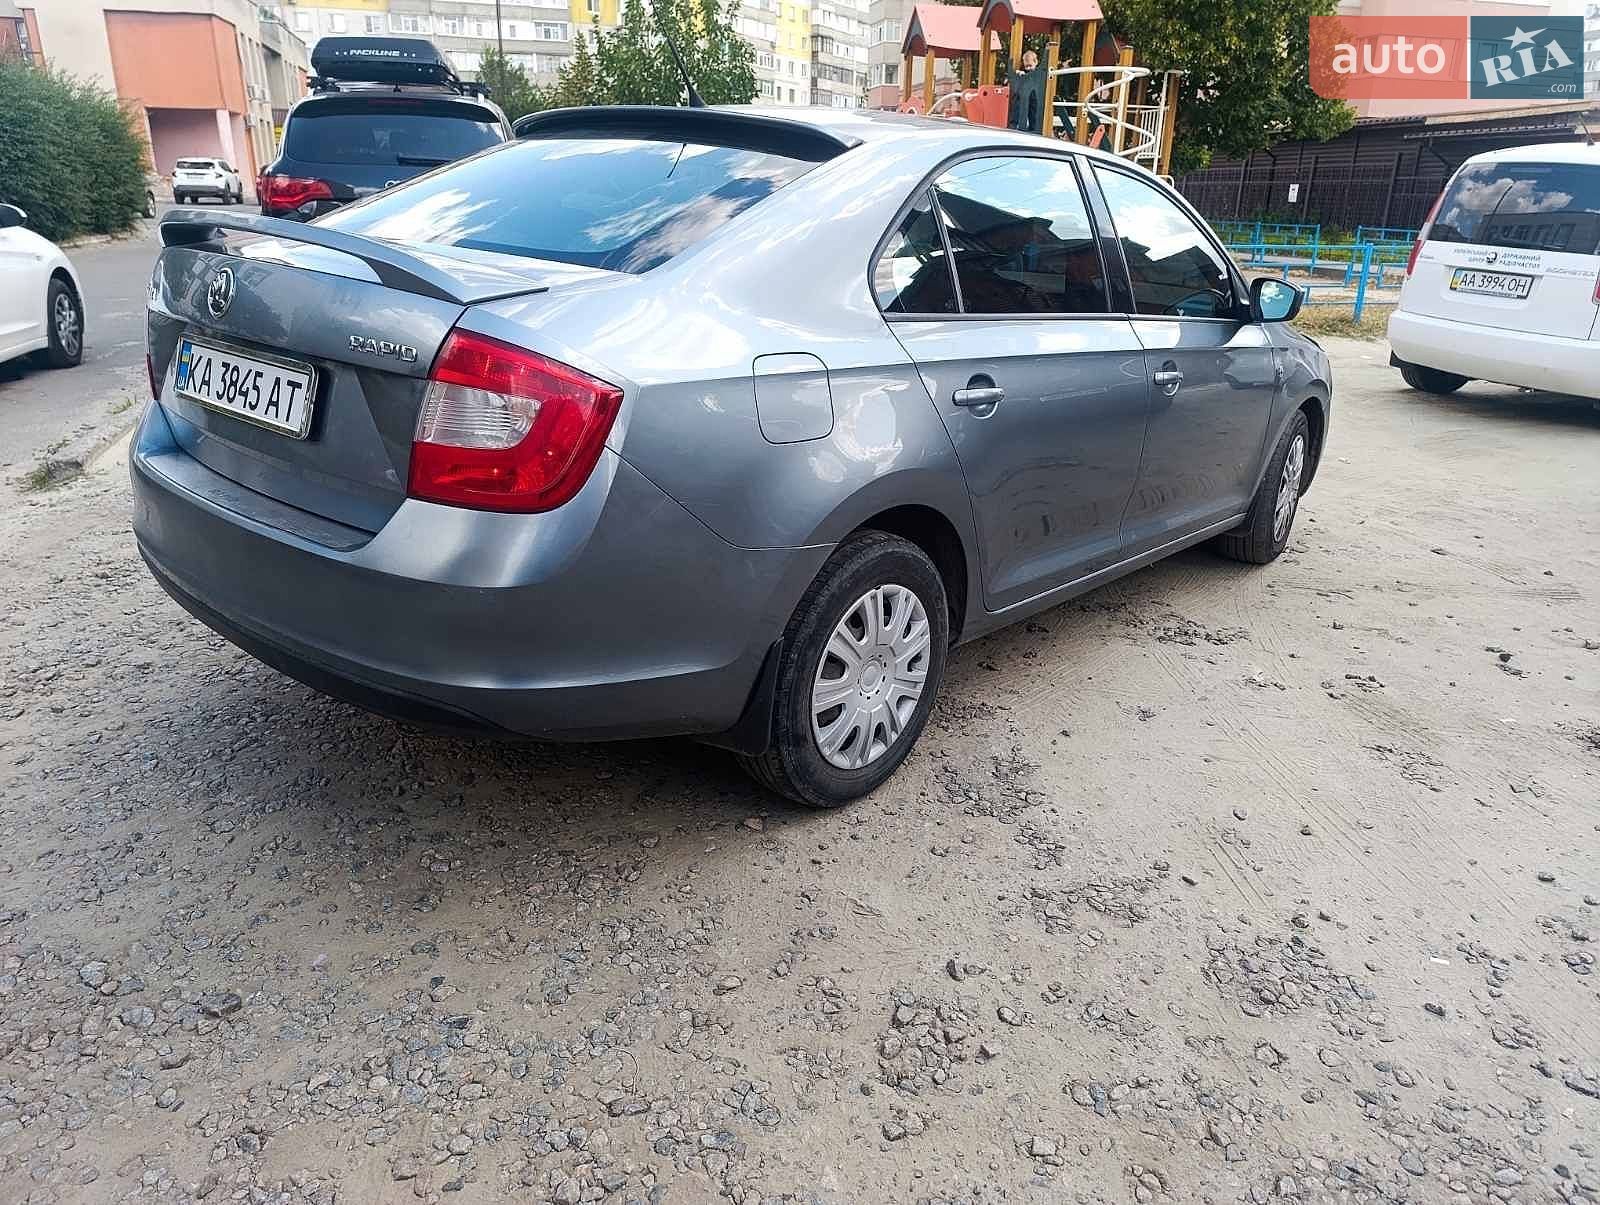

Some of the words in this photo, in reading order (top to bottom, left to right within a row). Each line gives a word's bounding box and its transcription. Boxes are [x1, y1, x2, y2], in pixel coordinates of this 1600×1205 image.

[349, 49, 400, 57] PACKLINE
[1460, 272, 1476, 287] AA
[1478, 274, 1506, 290] 3994
[1507, 278, 1527, 293] OH
[349, 335, 418, 362] RAPID
[186, 352, 211, 396] KA
[216, 361, 264, 411] 3845
[264, 376, 303, 422] AT
